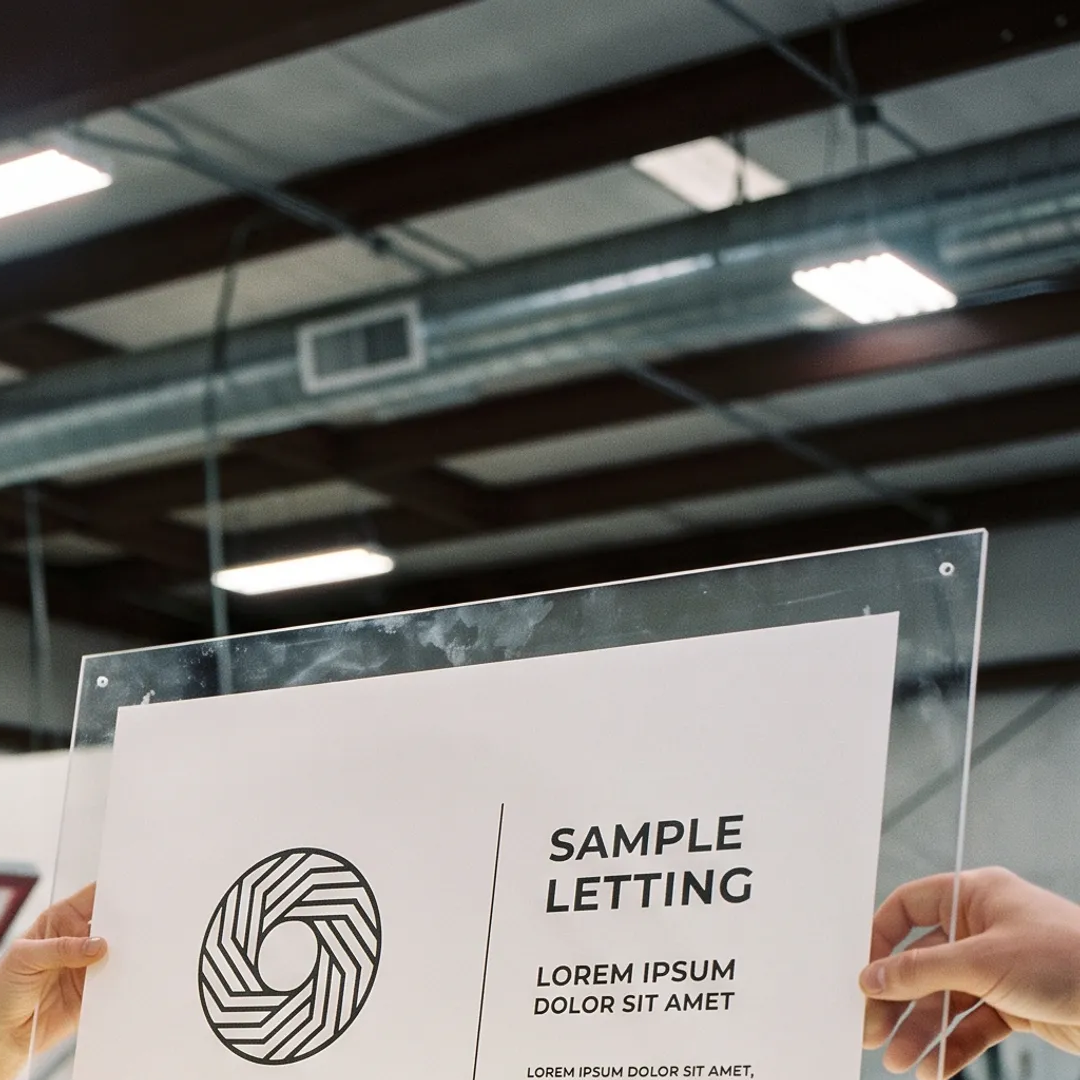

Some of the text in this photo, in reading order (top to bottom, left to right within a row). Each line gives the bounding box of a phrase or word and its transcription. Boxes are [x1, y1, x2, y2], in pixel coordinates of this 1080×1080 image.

[549, 814, 743, 861] SAMPLE
[546, 867, 752, 913] LETTING
[537, 959, 735, 987] LOREM IPSUM
[534, 991, 735, 1014] DOLOR SIT AMET
[528, 1064, 755, 1079] LOREM IPSUM DOLOR SIT AMET,
